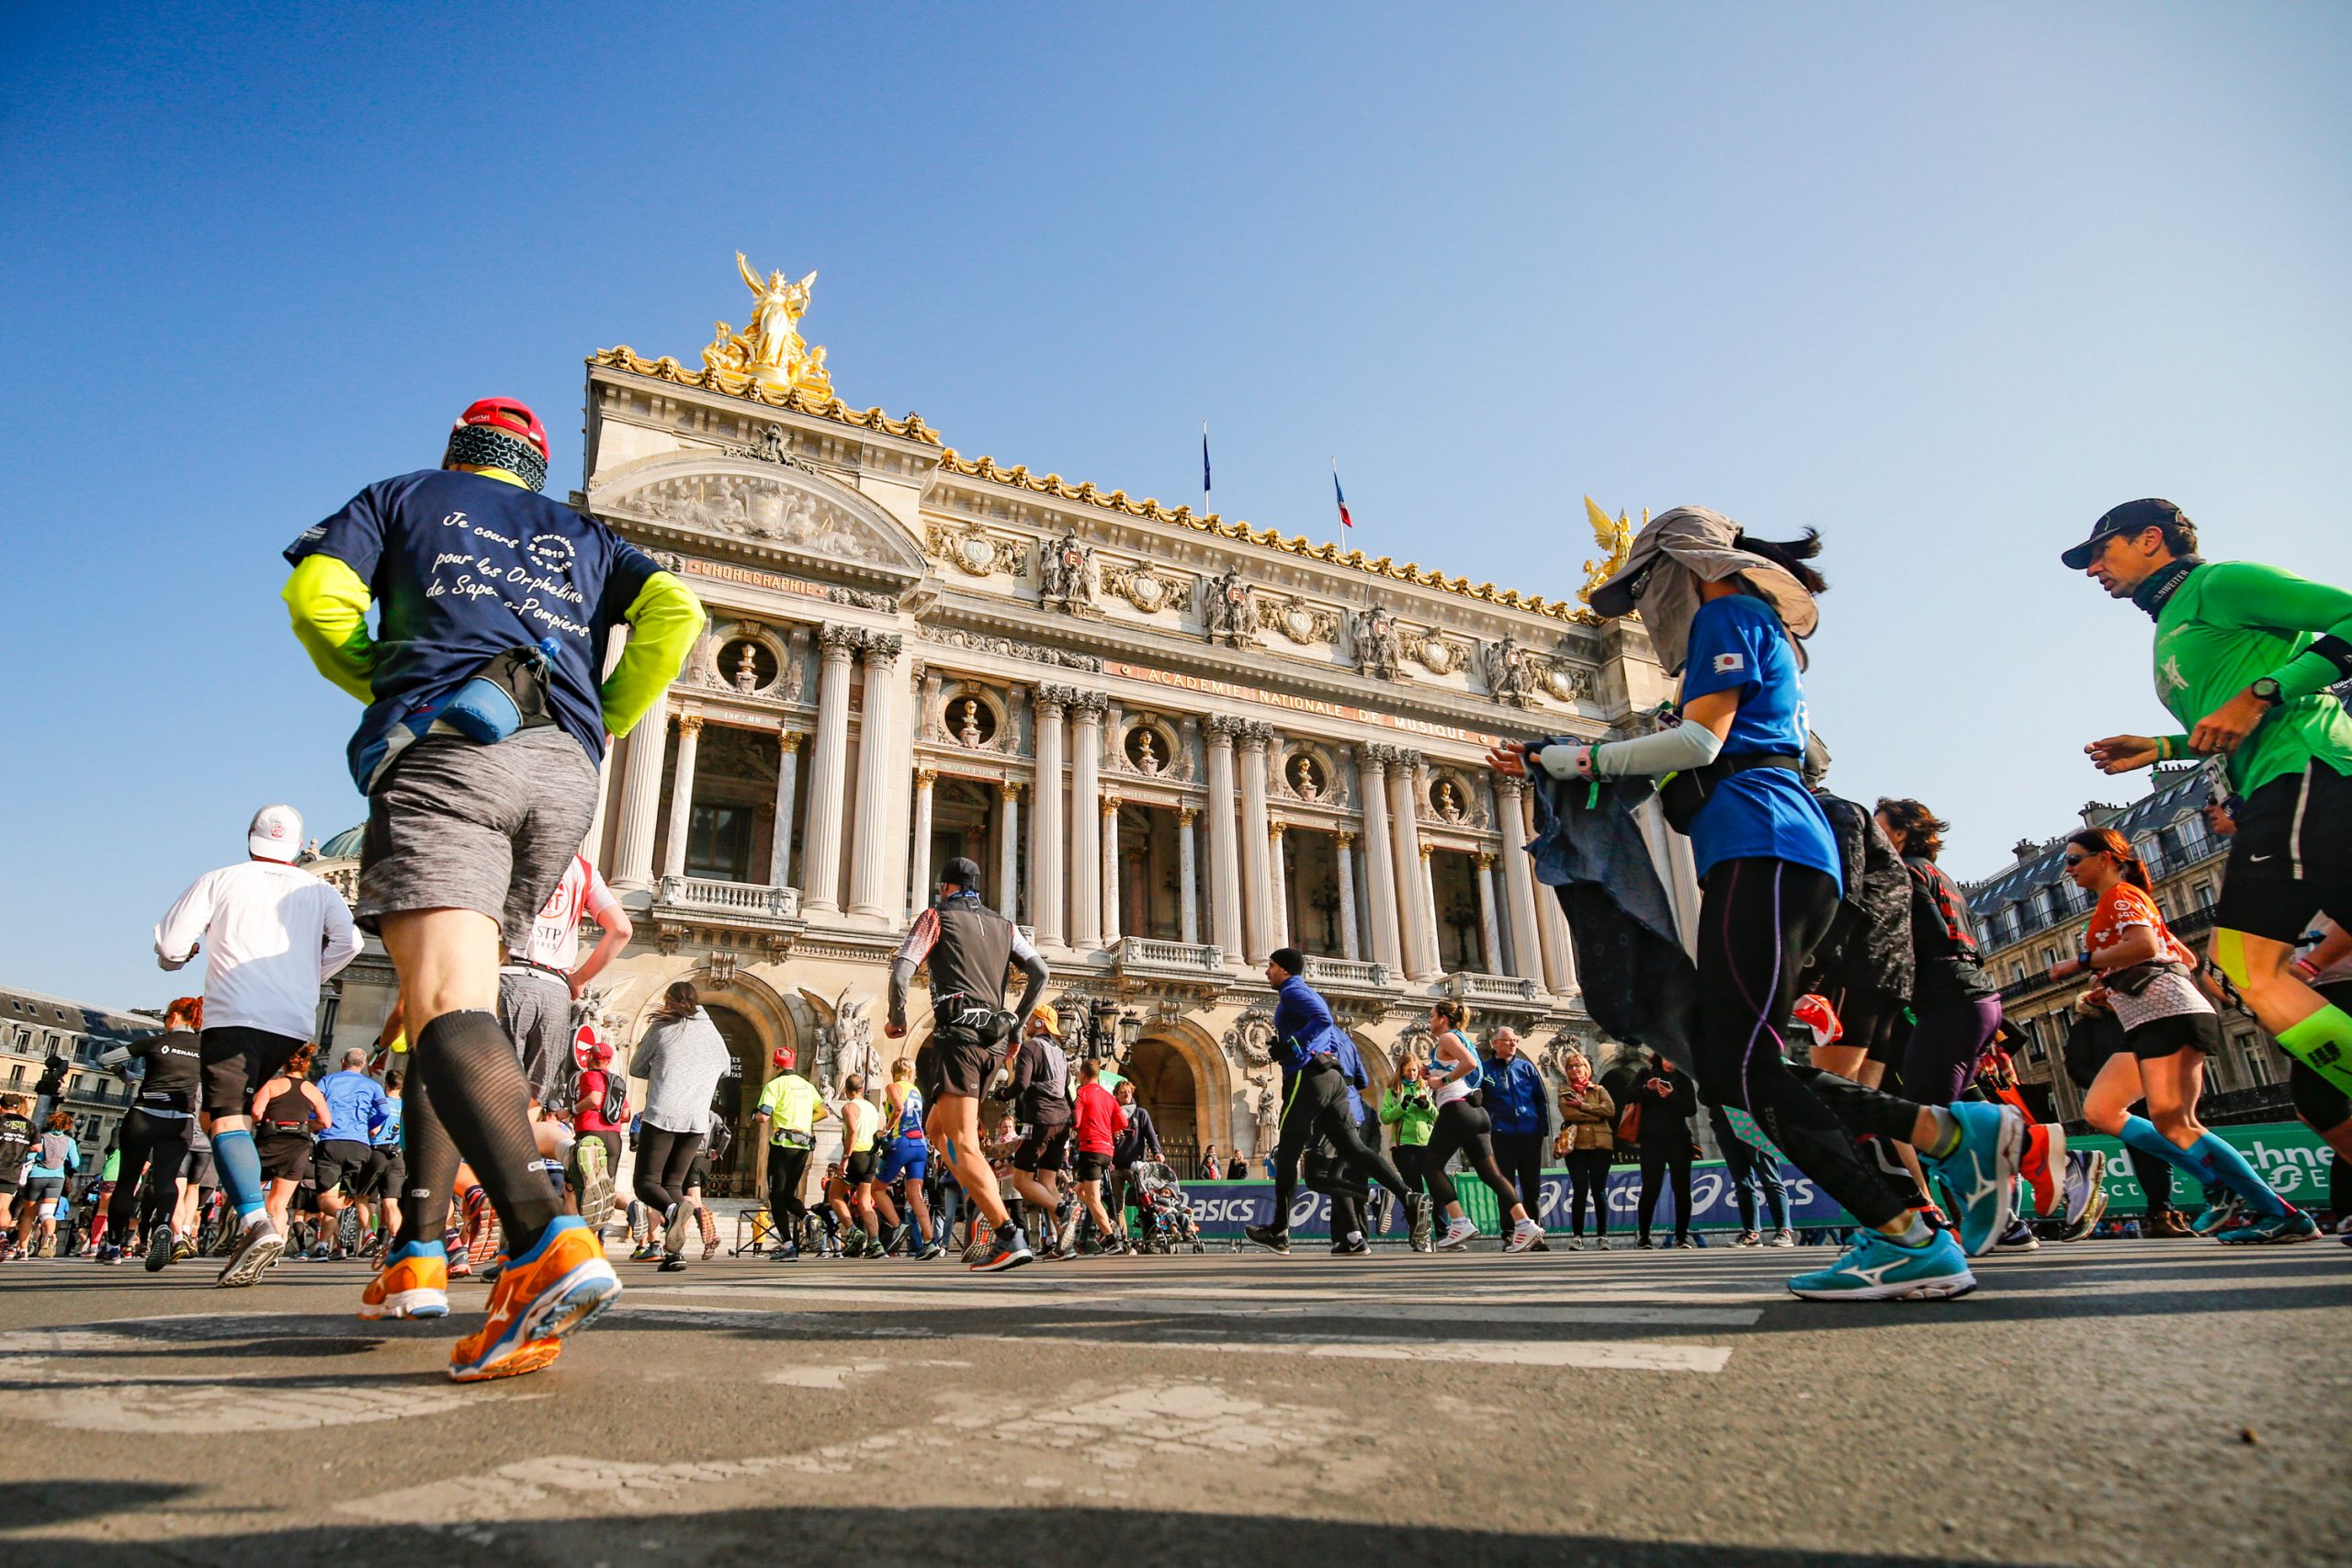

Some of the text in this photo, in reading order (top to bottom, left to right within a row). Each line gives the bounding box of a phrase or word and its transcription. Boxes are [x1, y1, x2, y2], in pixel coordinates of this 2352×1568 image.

[443, 512, 520, 549] Je cours
[532, 534, 576, 558] Marathon
[537, 547, 565, 558] 2019
[425, 578, 446, 598] de
[431, 552, 583, 604] pour les Orphelins
[702, 562, 815, 594] CHOREGRAPHIE
[1148, 669, 1467, 741] ACADEMIE NATIONALE DE MUSIQUE
[171, 1048, 200, 1058] RENAUL
[1192, 1199, 1256, 1222] asics
